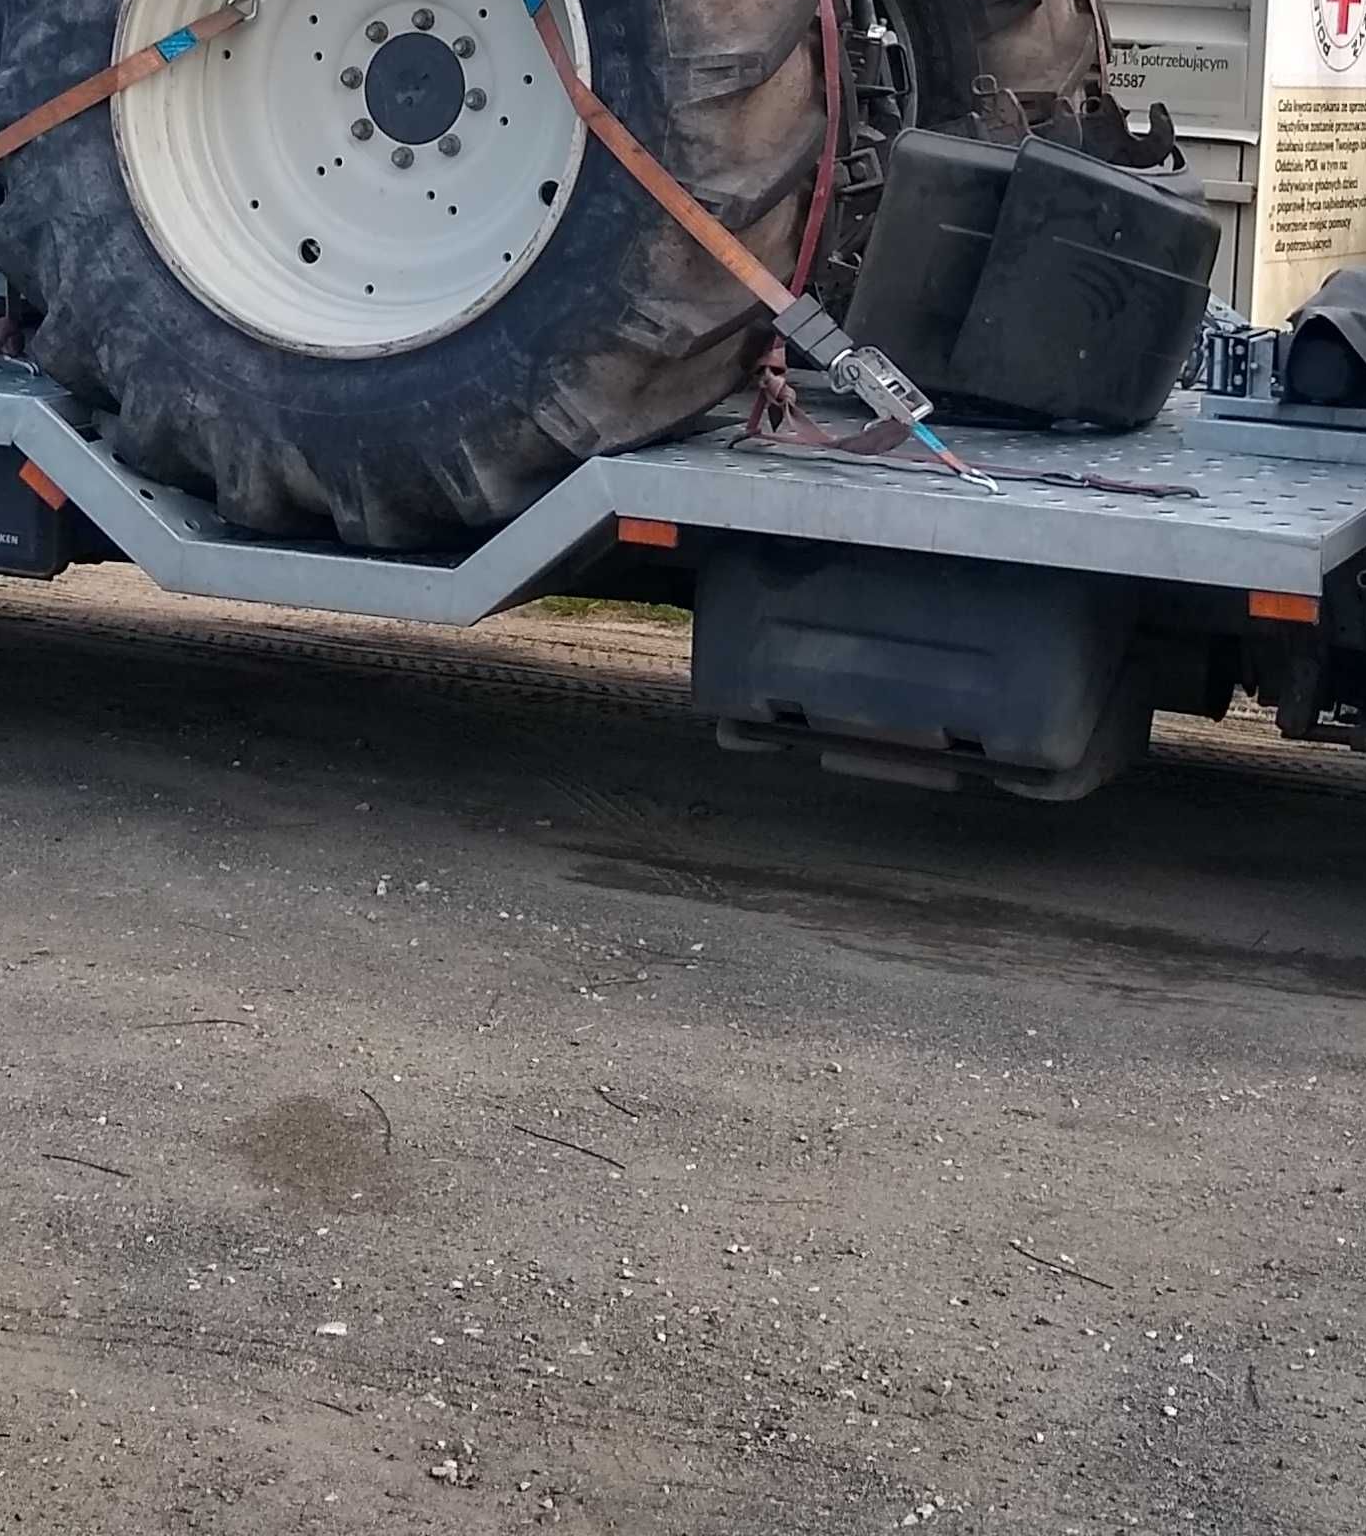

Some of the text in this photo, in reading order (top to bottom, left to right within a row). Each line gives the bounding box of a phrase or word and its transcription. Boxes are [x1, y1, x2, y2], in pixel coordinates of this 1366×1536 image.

[1122, 51, 1140, 66] 1%
[1141, 54, 1229, 72] potrzebującym
[1304, 158, 1318, 172] PCK
